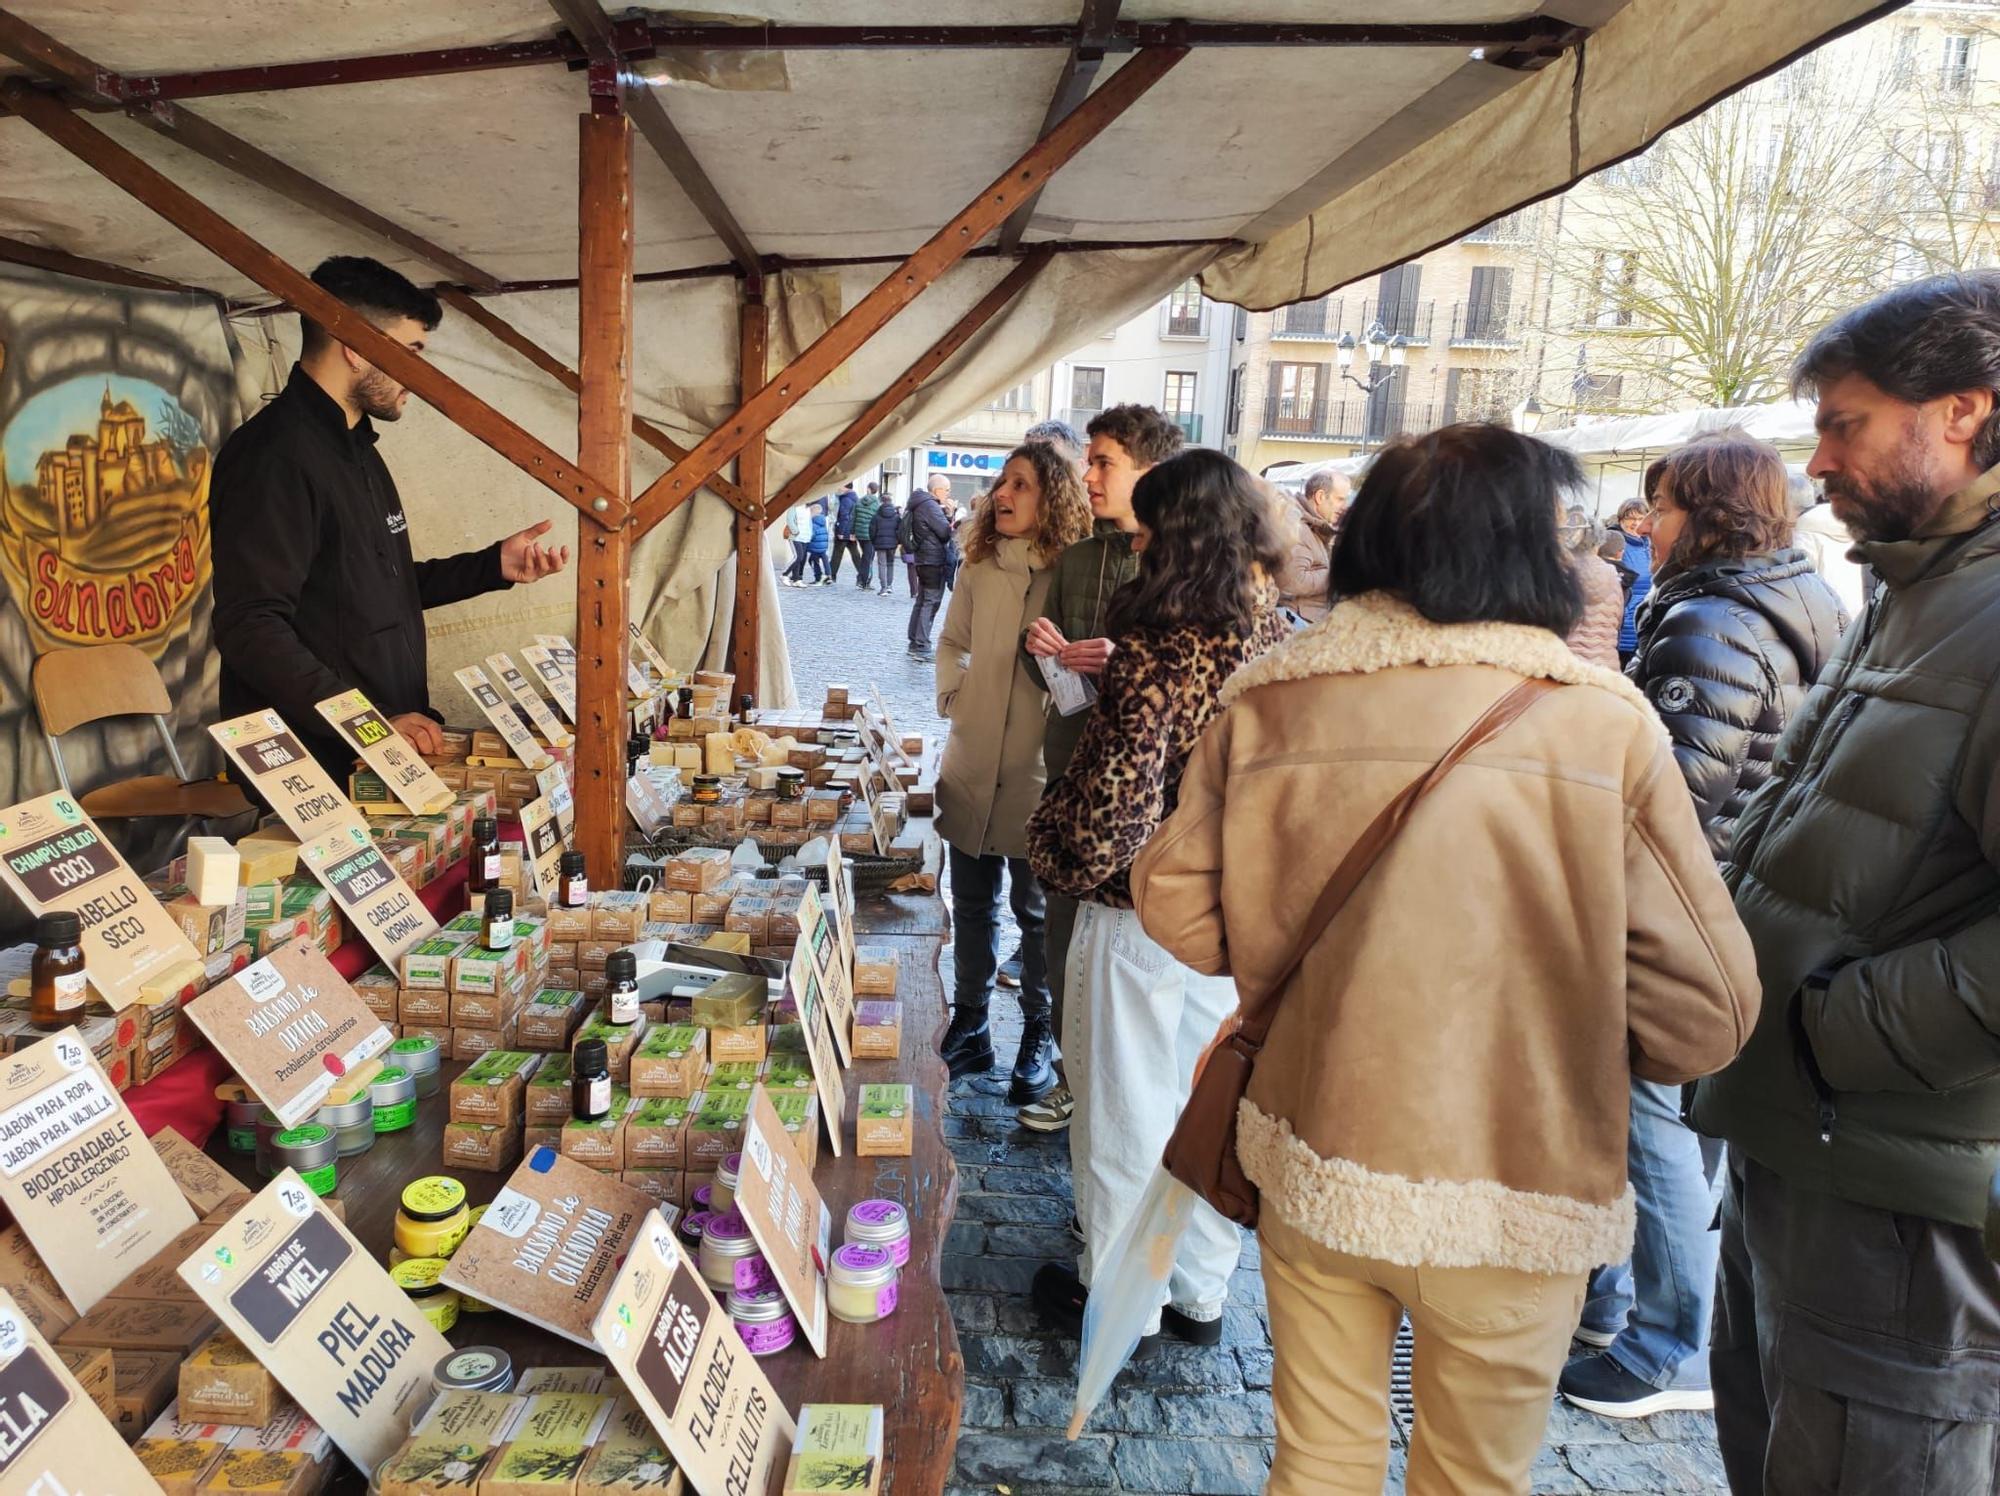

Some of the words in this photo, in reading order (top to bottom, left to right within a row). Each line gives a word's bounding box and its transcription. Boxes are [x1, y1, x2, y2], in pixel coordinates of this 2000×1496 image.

[34, 536, 196, 639] Sanabria
[56, 800, 73, 814] 10
[282, 774, 315, 796] PIEL
[49, 855, 96, 887] COCO
[348, 868, 387, 897] ABEDUL
[76, 885, 138, 932] ABELLO
[101, 916, 145, 949] SECO
[366, 892, 411, 927] CABELLO
[382, 913, 423, 945] NORMAL
[244, 991, 302, 1039] BÁLSAMO
[298, 983, 319, 1002] de
[278, 1008, 329, 1053] ORTIGA
[275, 1048, 317, 1082] Problemas
[315, 1016, 358, 1051] circulatorios
[0, 1112, 38, 1142] JABÓN
[35, 1095, 67, 1120] PARA
[64, 1079, 95, 1103] ROPA
[2, 1138, 42, 1168] JABÓN
[40, 1120, 71, 1145] PARA
[69, 1095, 112, 1127] VAJILLA
[22, 1120, 132, 1200] BIODEGRADABLE
[288, 1238, 307, 1258] DE
[512, 1211, 569, 1276] BÁLSAMO
[552, 1194, 581, 1214] de
[548, 1207, 614, 1287] CALÉNDULA
[574, 1250, 612, 1303] Hidratante
[603, 1229, 624, 1249] Piel
[617, 1212, 633, 1231] seca
[276, 1257, 330, 1309] MIEL
[667, 1293, 680, 1316] DE
[317, 1300, 381, 1368] PIEL
[662, 1304, 701, 1386] ALGAS
[336, 1317, 417, 1419] MADURA
[688, 1336, 735, 1454] FLACIDEZ
